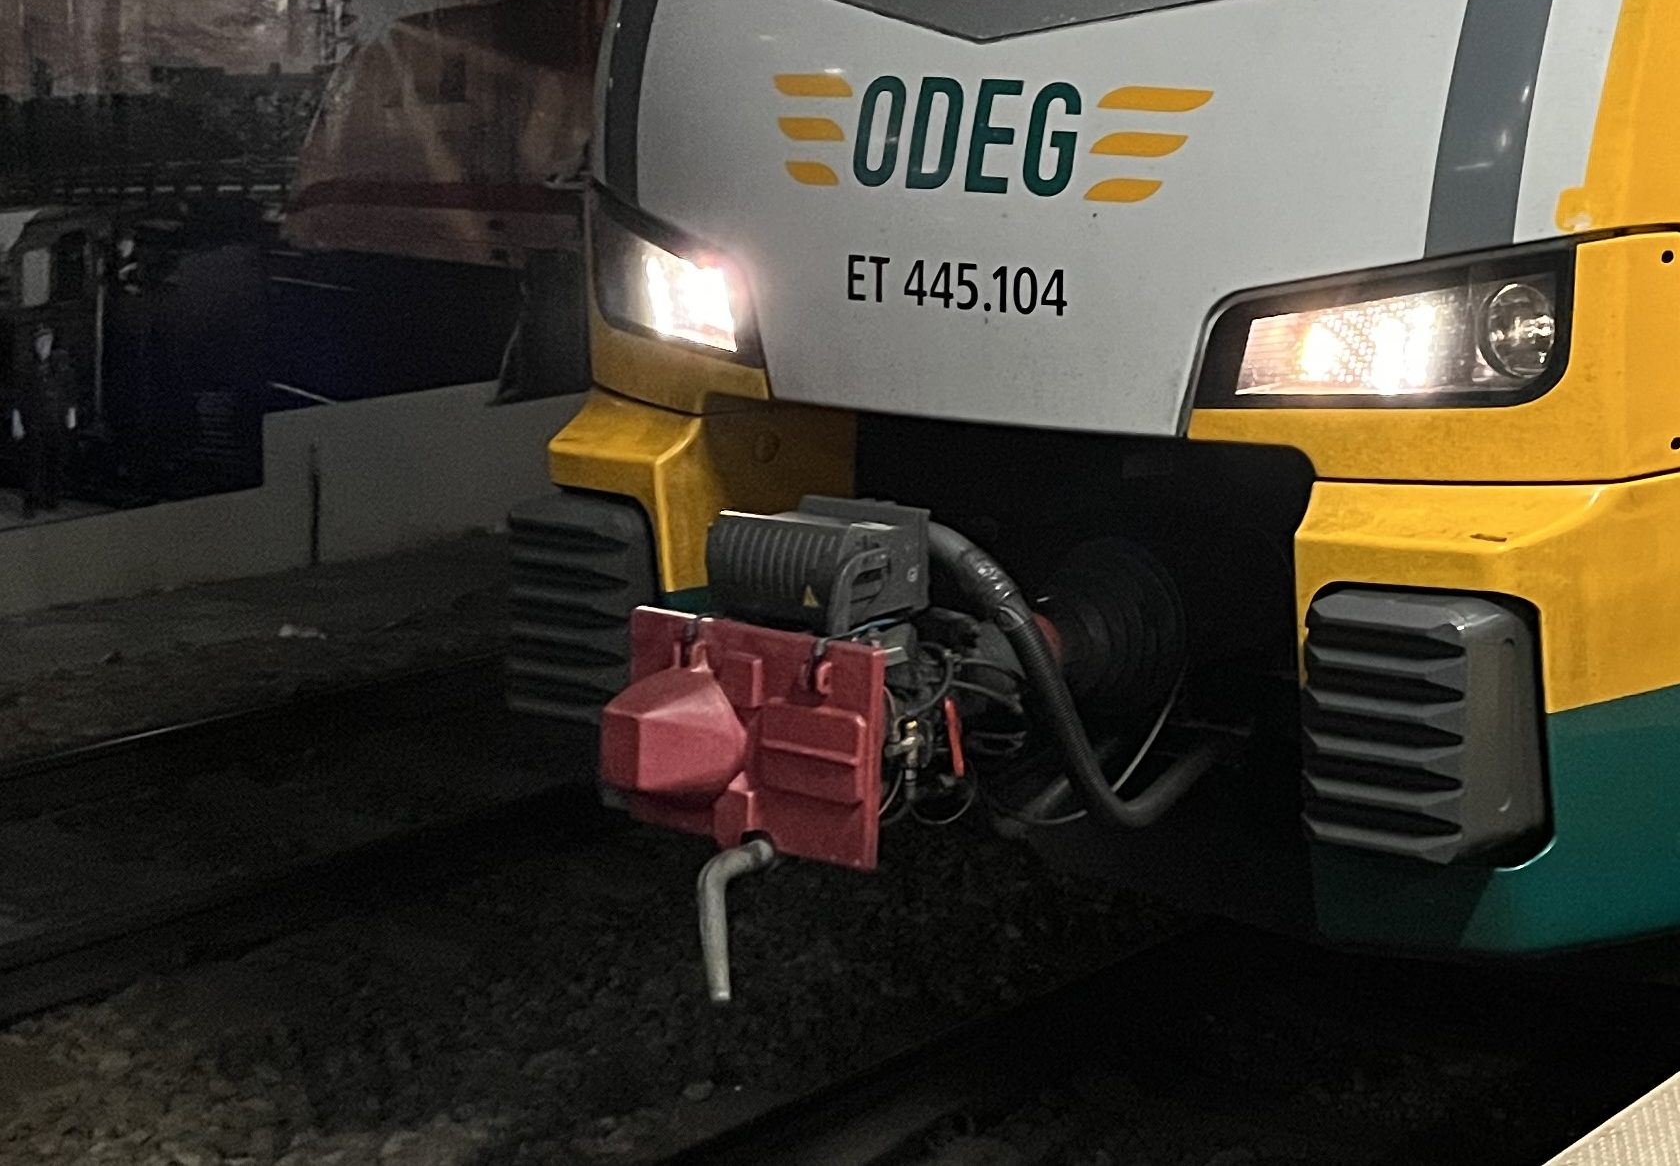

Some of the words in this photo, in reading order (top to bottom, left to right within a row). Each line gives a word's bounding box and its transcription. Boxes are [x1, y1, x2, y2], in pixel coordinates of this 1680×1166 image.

[852, 75, 1083, 198] ODEG
[846, 254, 891, 303] ET
[903, 259, 1068, 316] 445.104
